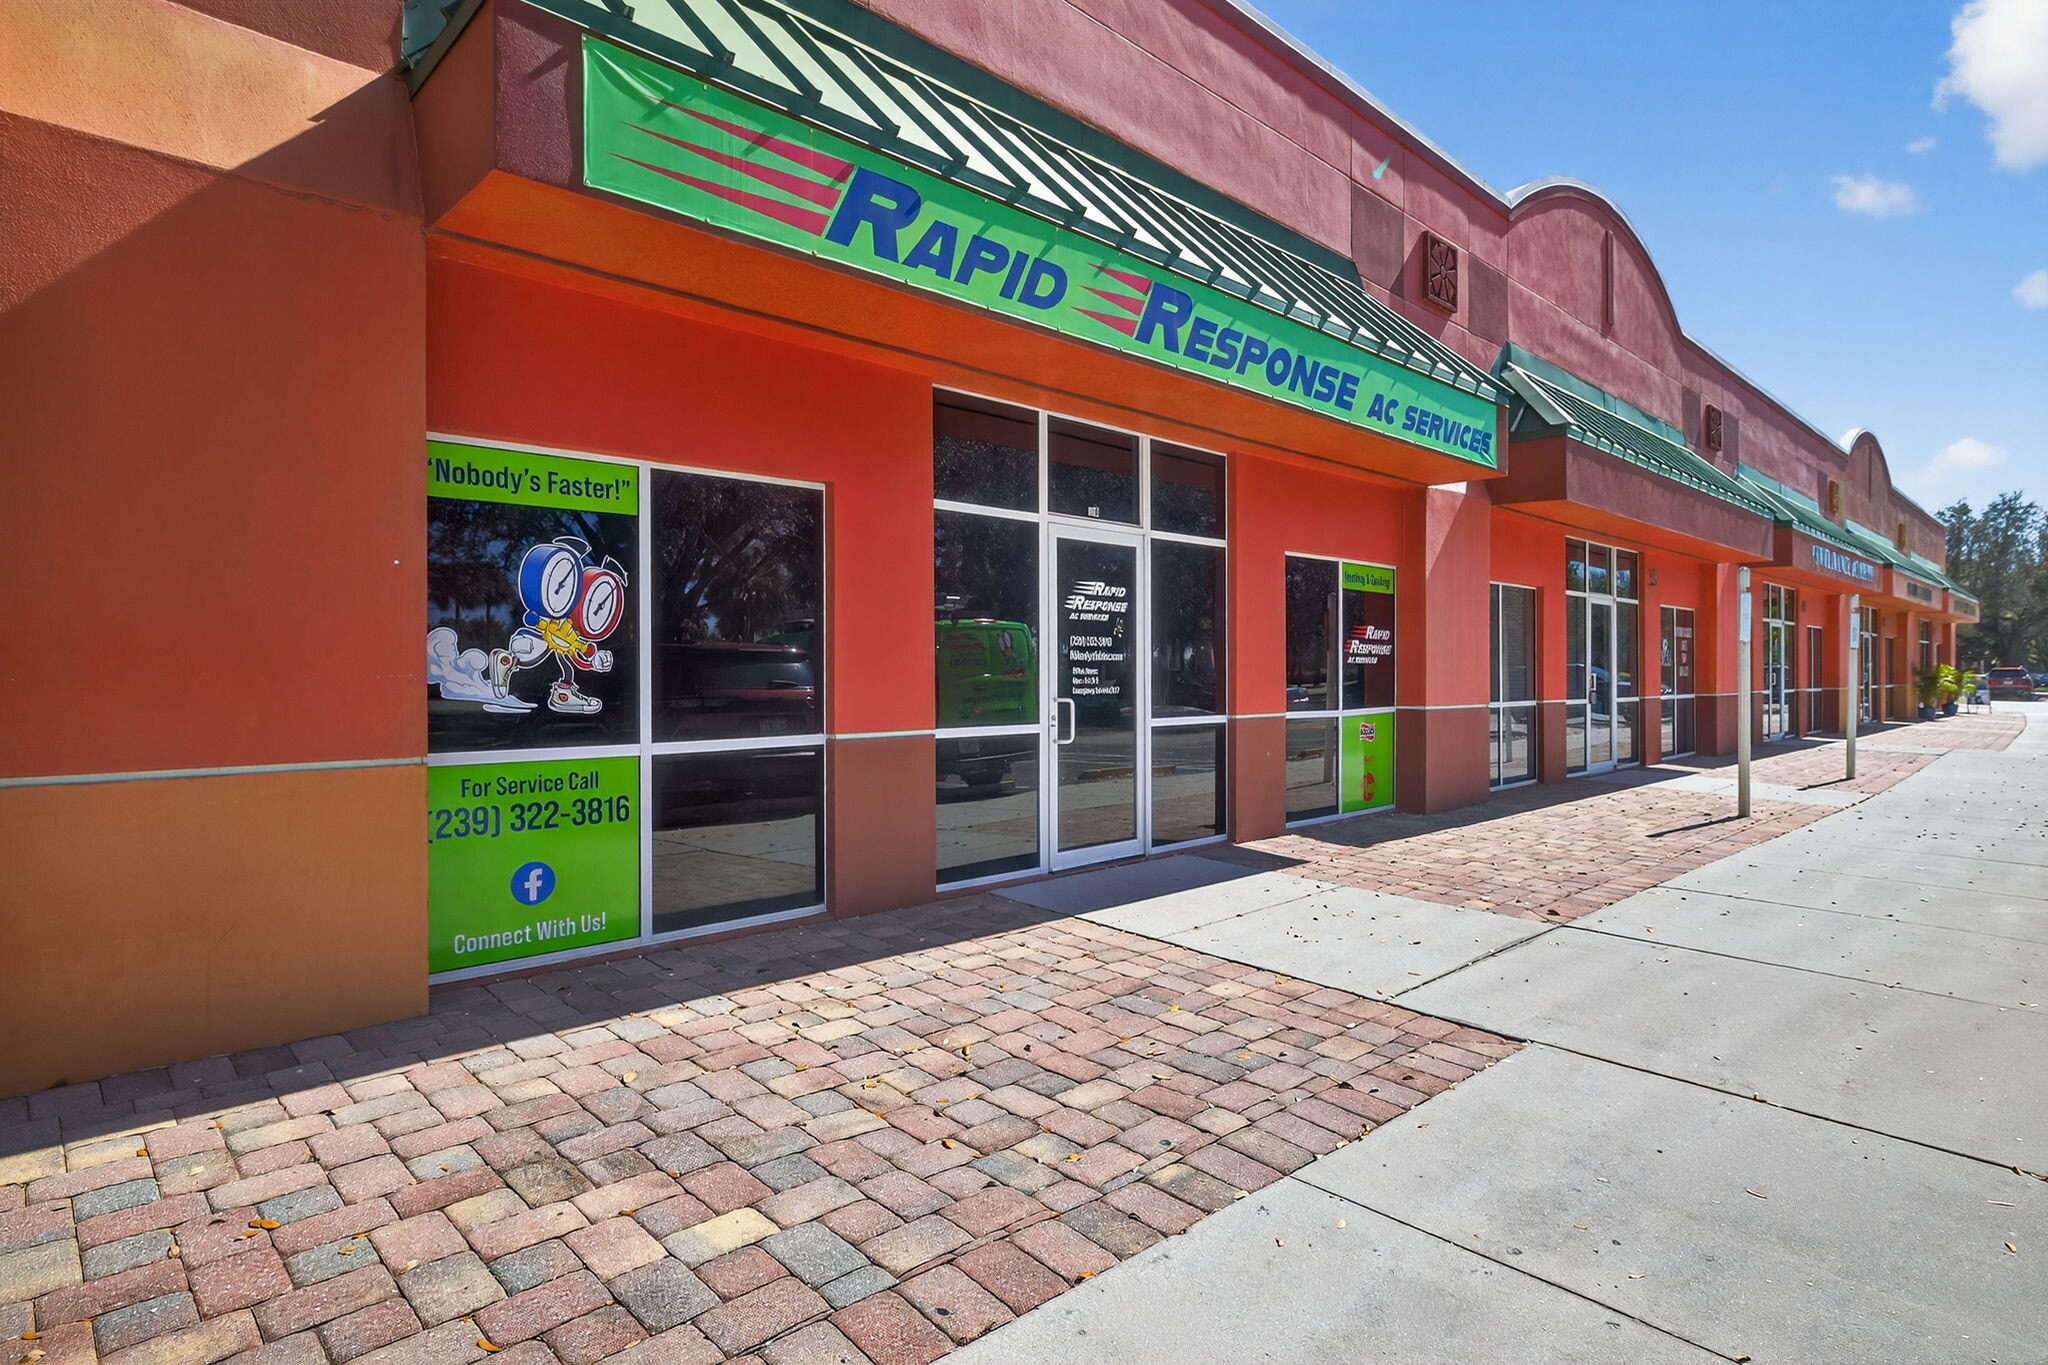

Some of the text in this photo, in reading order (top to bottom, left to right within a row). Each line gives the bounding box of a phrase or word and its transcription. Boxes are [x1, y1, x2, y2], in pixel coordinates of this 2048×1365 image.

[825, 167, 1494, 455] RAPID RESPONSE AC SERVICES
[547, 470, 631, 500] Faster!"
[1093, 581, 1127, 598] RAPID
[1073, 595, 1129, 613] RESPONSE
[1365, 625, 1391, 641] RAPID
[461, 771, 599, 798] For Service Call
[509, 795, 631, 832] 322-3816
[454, 911, 606, 955] Connect With Us!
